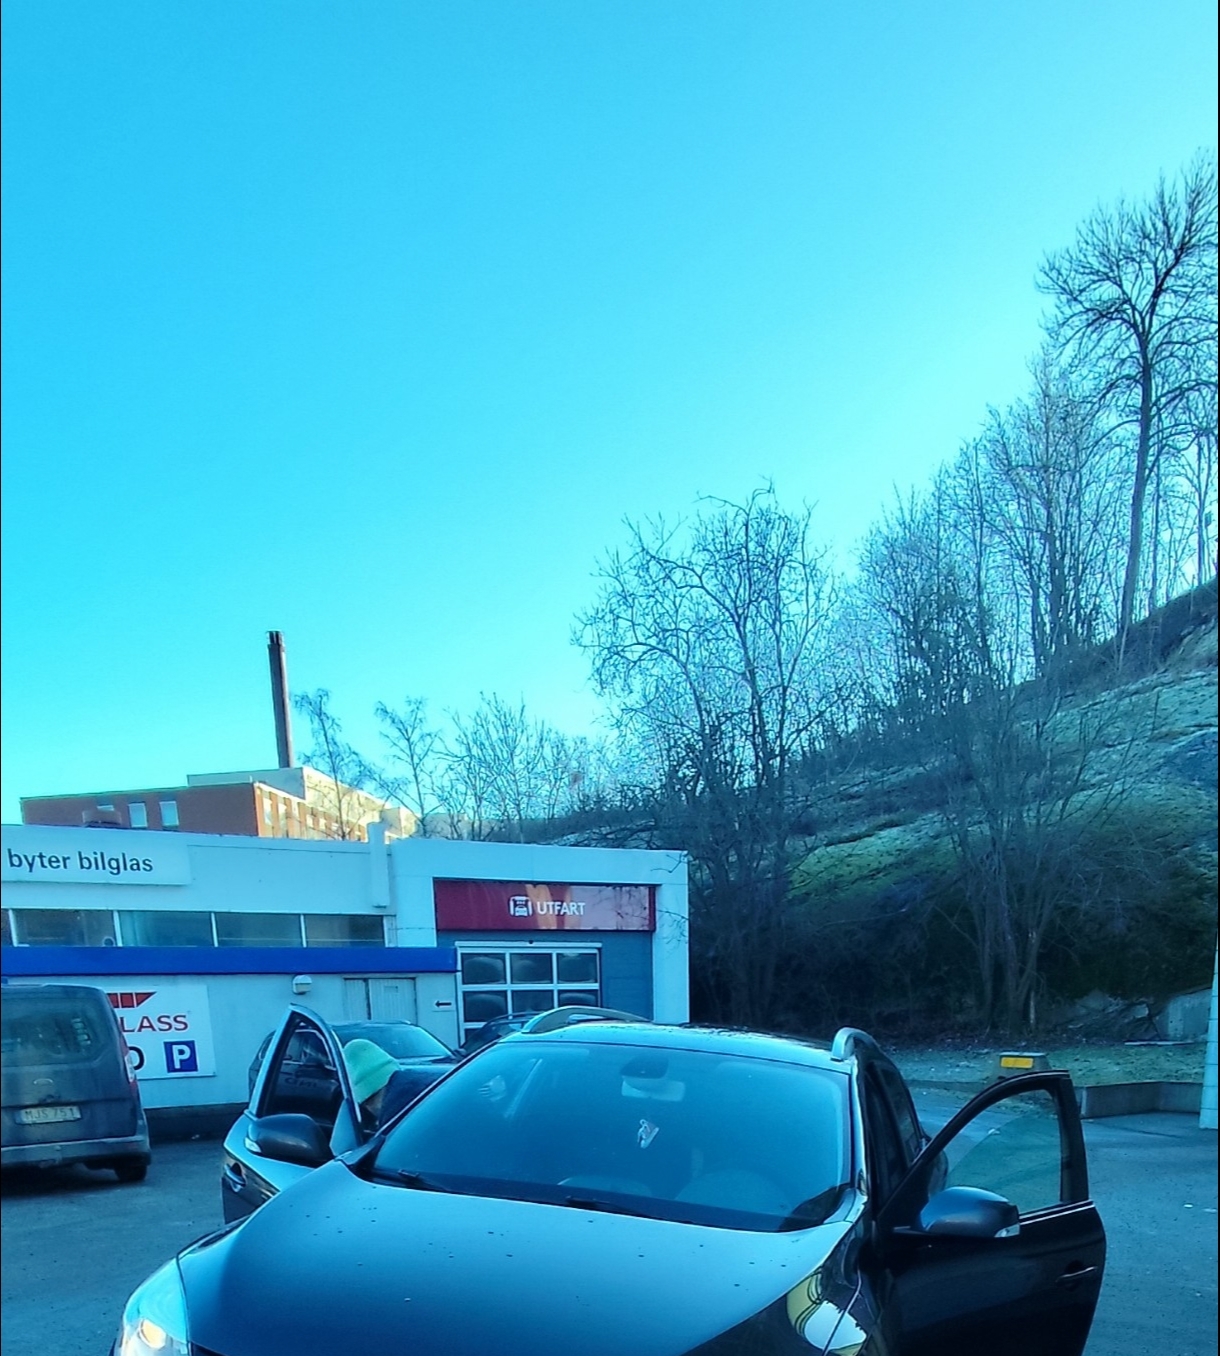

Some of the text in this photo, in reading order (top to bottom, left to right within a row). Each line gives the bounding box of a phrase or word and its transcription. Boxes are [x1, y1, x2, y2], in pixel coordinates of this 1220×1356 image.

[7, 848, 154, 876] byter bilglas
[536, 901, 586, 916] UTFART
[172, 1044, 191, 1070] P
